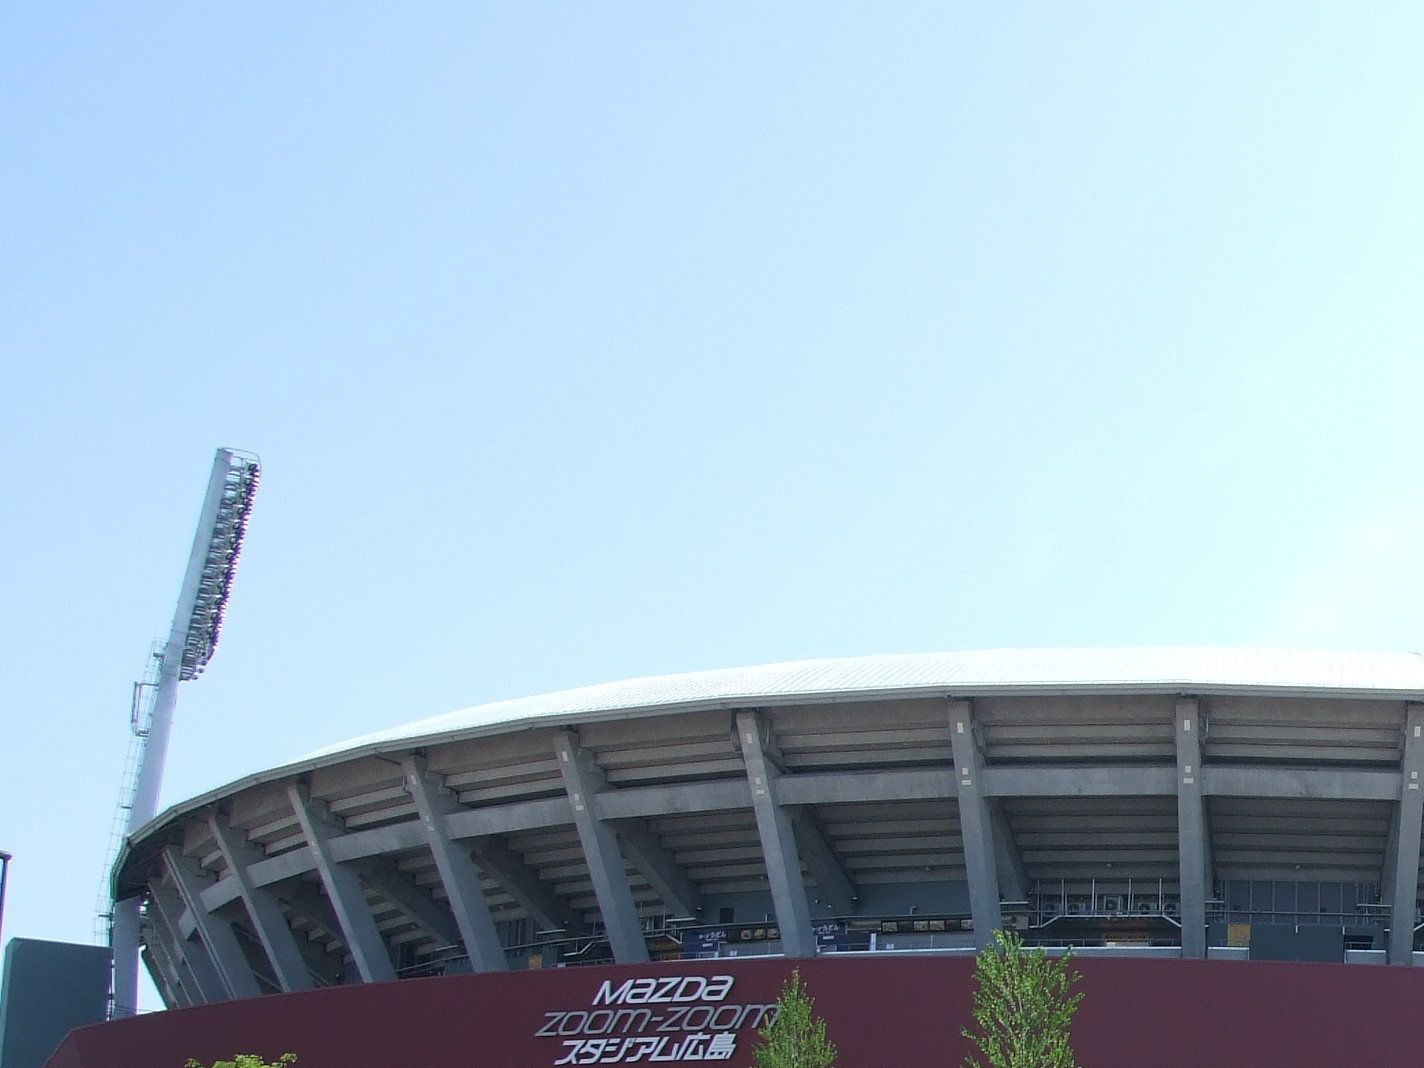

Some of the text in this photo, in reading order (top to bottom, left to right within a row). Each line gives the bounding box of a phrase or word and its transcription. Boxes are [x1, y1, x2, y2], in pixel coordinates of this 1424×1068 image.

[554, 1032, 737, 1066] スタジアム広島
